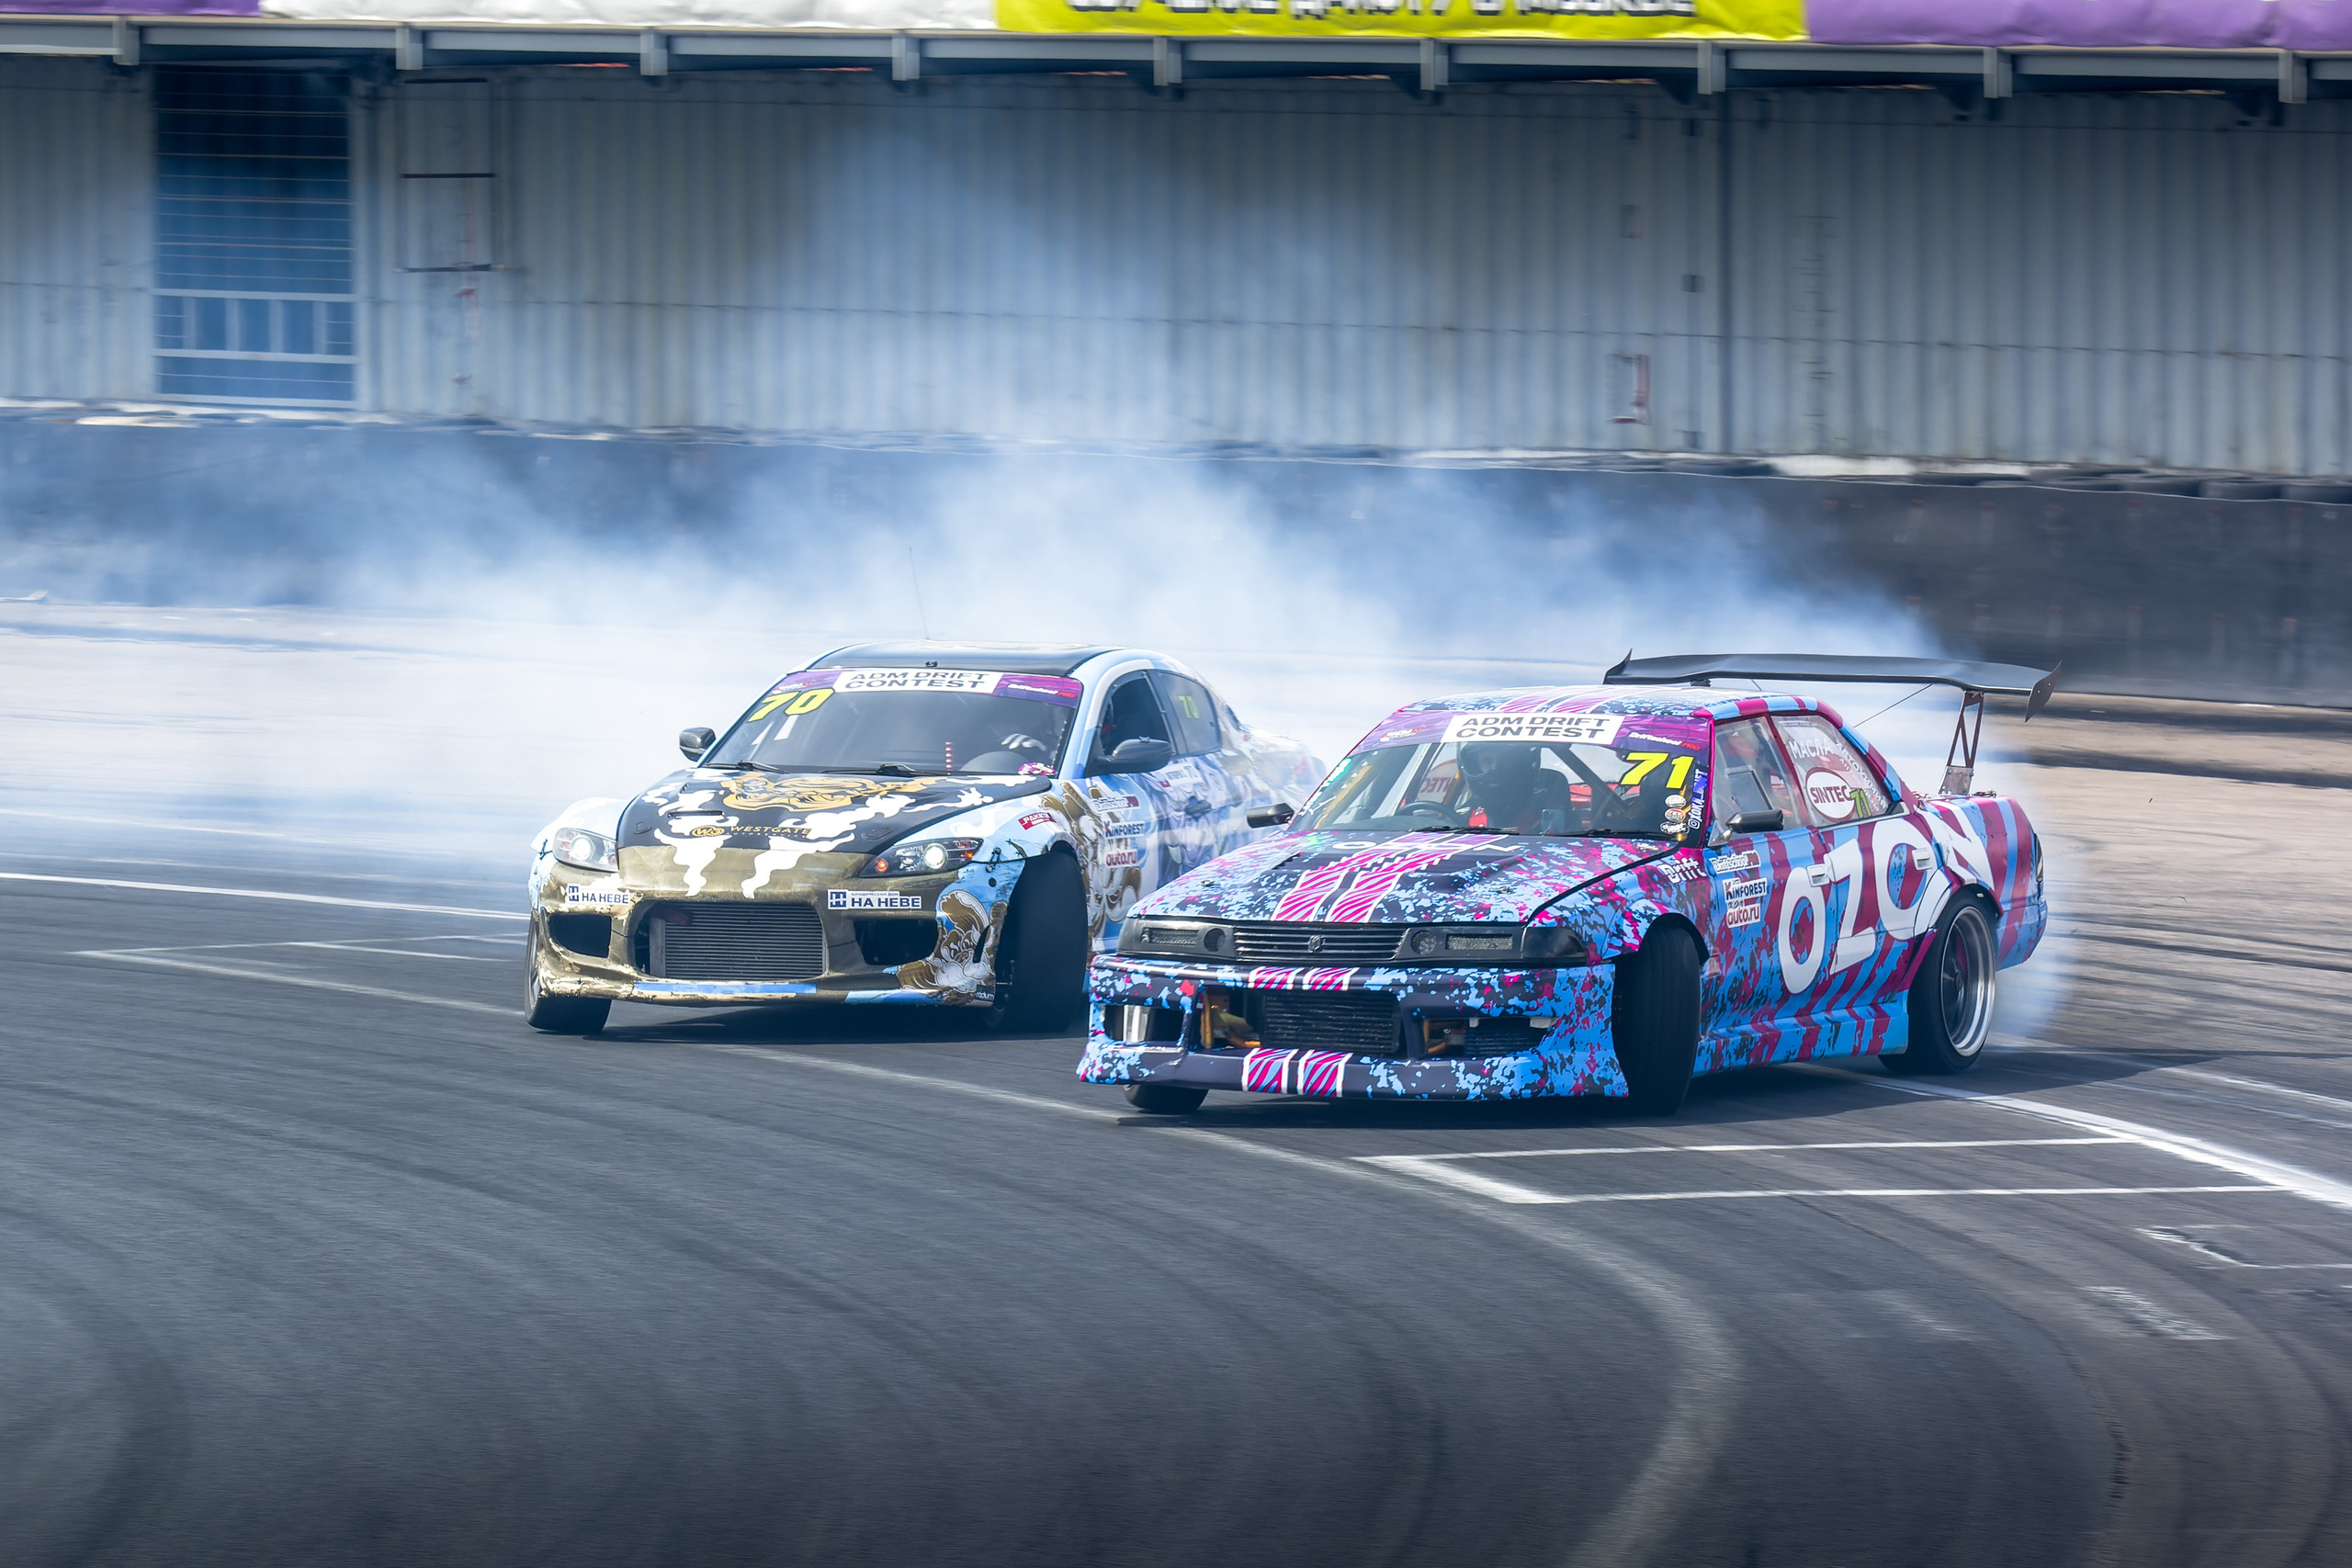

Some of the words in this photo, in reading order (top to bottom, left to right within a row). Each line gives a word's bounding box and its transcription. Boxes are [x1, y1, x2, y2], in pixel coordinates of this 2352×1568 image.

[851, 672, 908, 681] ADM
[914, 671, 989, 681] DRIFT
[845, 679, 985, 689] CONTEST
[748, 688, 835, 723] 70
[1462, 717, 1521, 727] ADM
[1529, 716, 1610, 727] DRIFT
[1456, 727, 1605, 739] CONTEST
[1789, 737, 1834, 759] МАСЛА
[1621, 751, 1694, 789] 71
[1810, 784, 1852, 804] SINTEC
[1849, 788, 1872, 818] 71
[729, 826, 811, 835] WESTGATE
[1106, 851, 1137, 866] auto.ru
[582, 893, 597, 902] НА
[599, 893, 629, 904] НЕВЕ
[851, 897, 875, 908] НА
[877, 897, 921, 908] НЕВЕ
[1778, 800, 1996, 995] OZON
[1727, 905, 1760, 926] auto.ru
